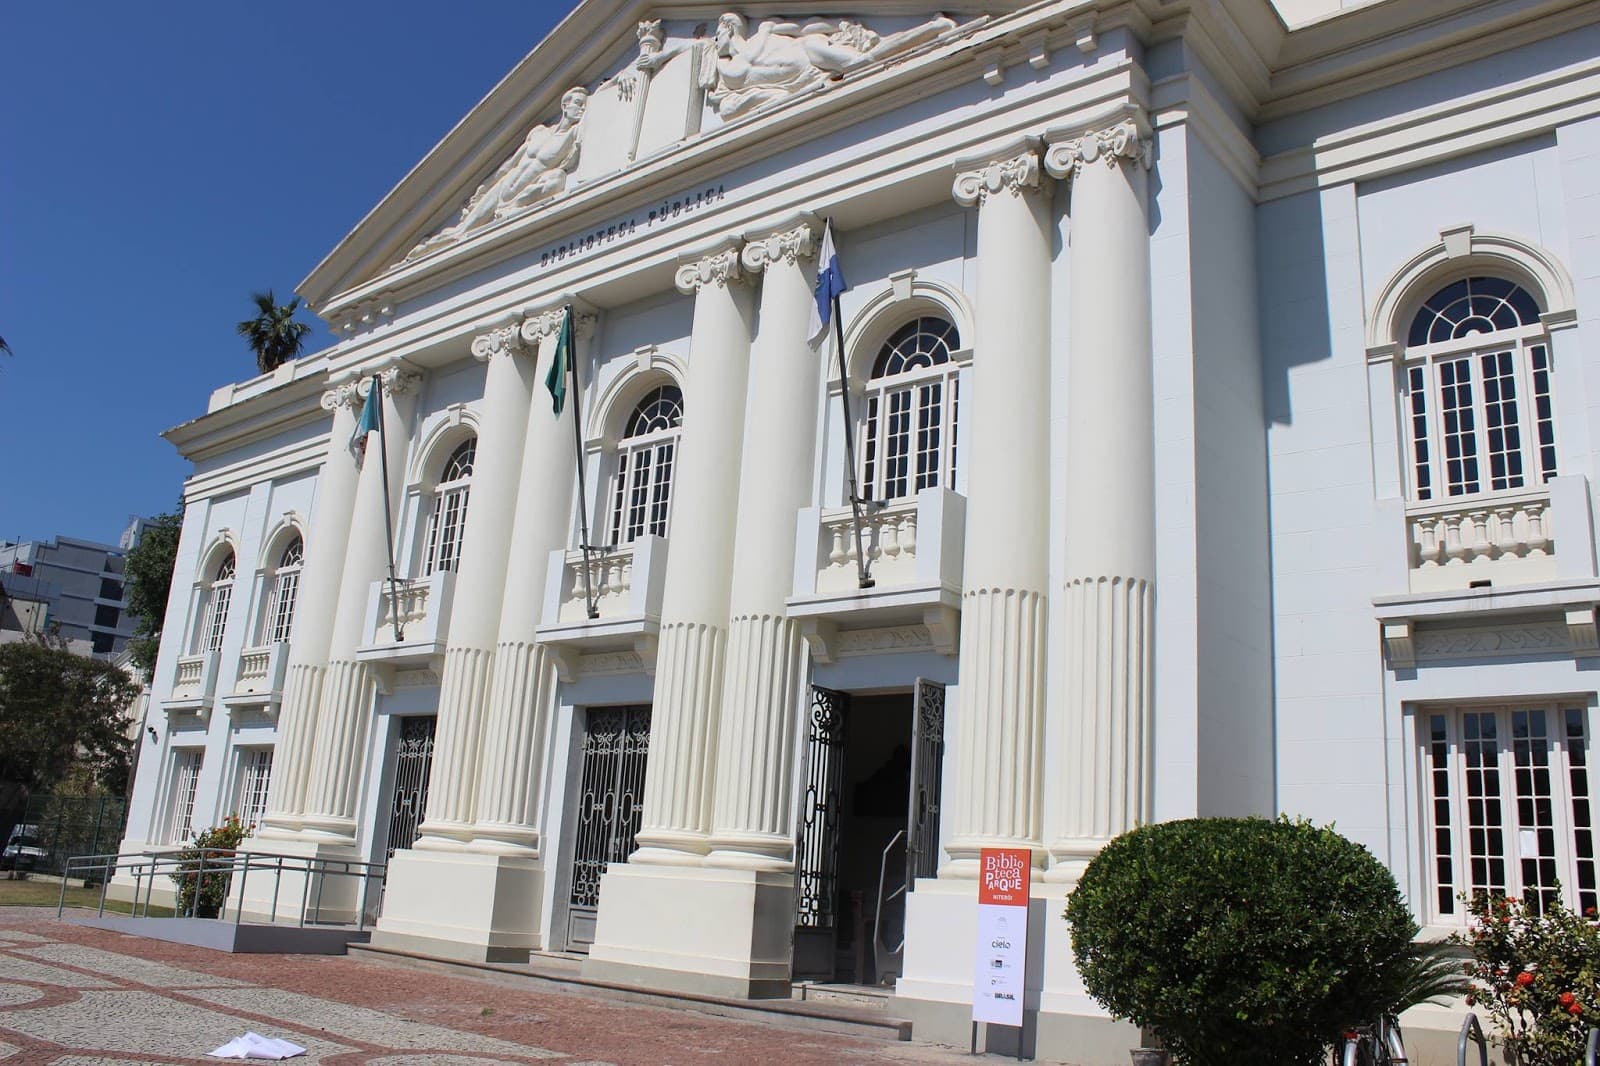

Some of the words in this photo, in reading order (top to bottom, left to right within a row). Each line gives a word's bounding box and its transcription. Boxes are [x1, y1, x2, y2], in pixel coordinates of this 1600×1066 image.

[540, 218, 636, 268] BIBLIOTECA
[648, 184, 725, 227] PÚBLICA
[985, 853, 1024, 870] Biblio
[985, 872, 1022, 892] PARQUE
[995, 867, 1021, 880] teca
